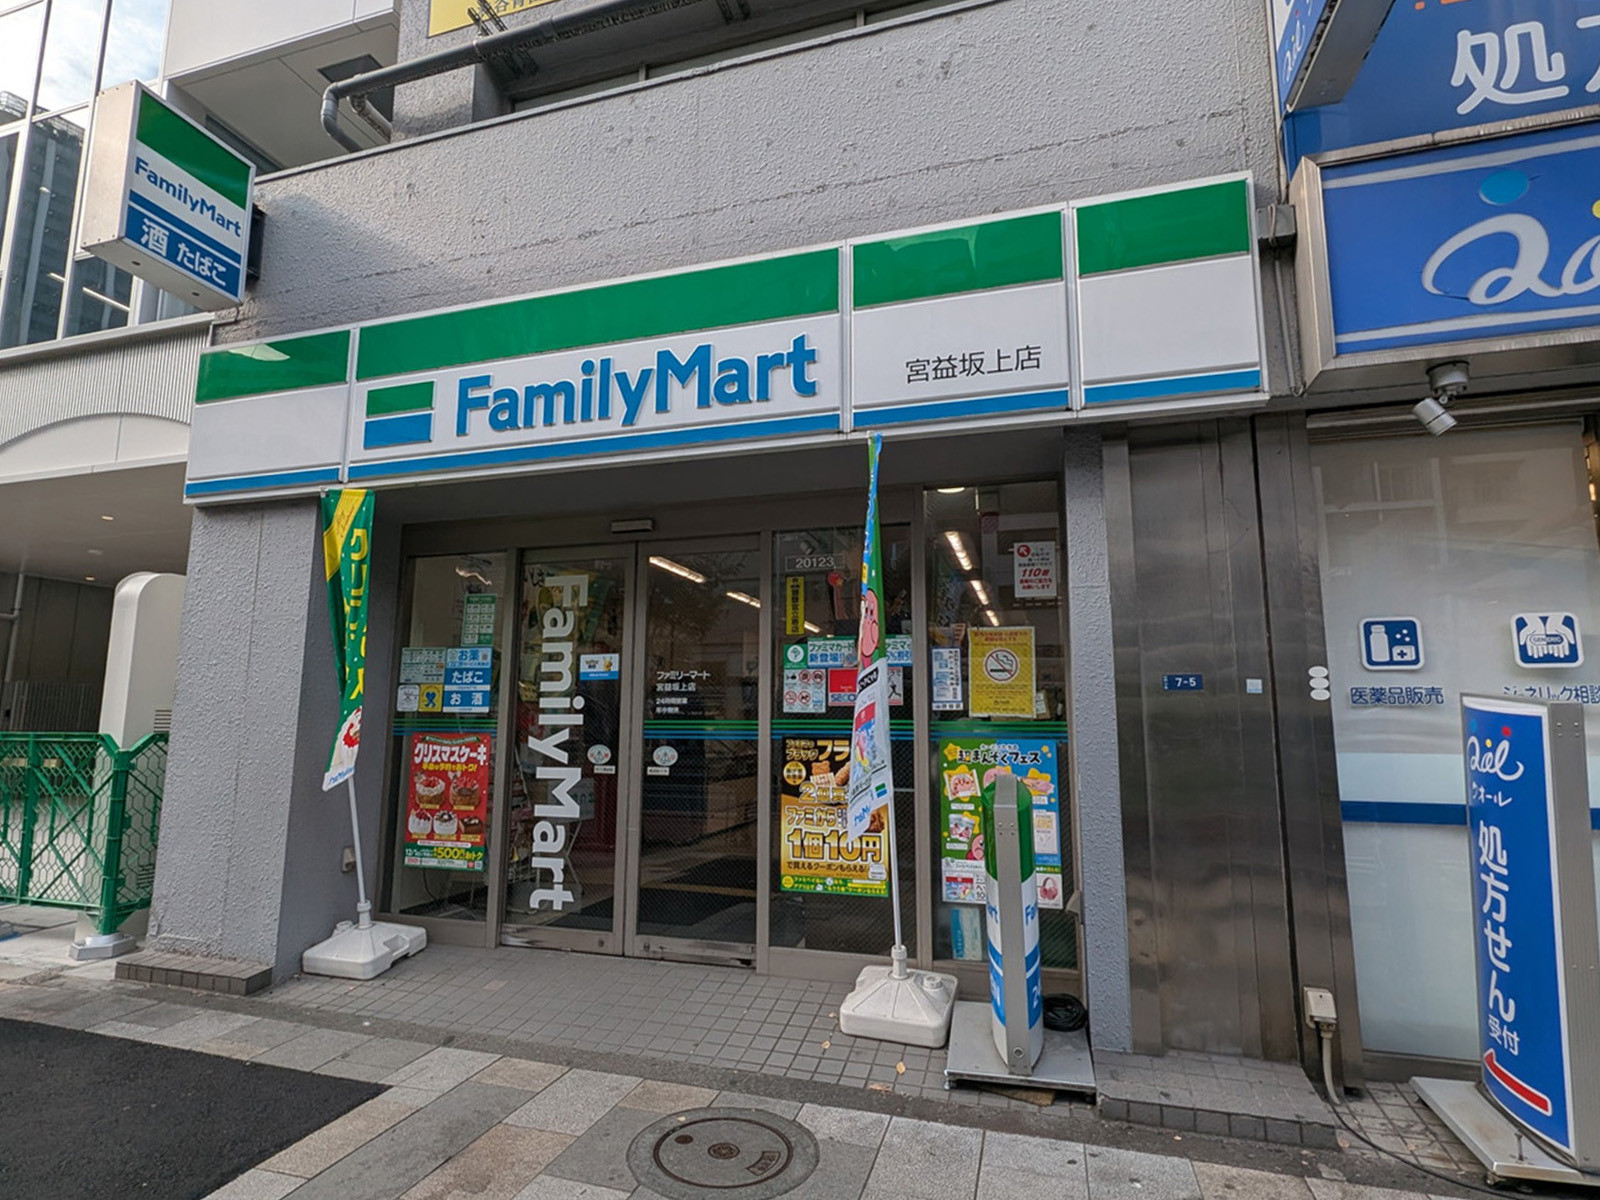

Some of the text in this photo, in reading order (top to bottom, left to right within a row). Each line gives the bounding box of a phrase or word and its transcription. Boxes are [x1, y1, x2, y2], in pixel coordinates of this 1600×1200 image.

[1450, 15, 1600, 116] 処
[134, 156, 242, 238] FamilyMart
[140, 217, 227, 287] 酒 たばこ
[905, 345, 1041, 384] 宮益坂上店
[455, 333, 817, 437] FamilyMart
[795, 557, 835, 569] 20123
[452, 671, 484, 683] たばこ
[656, 670, 711, 680] ファミリーマート
[1174, 676, 1197, 688] 7-5
[1350, 686, 1445, 705] 医薬品販売
[413, 743, 487, 765] クリスマスケーキ
[528, 575, 589, 911] FamilyMart
[1471, 782, 1513, 807] クオール
[1478, 819, 1516, 1023] 処方せん
[1487, 1013, 1521, 1056] 受付
